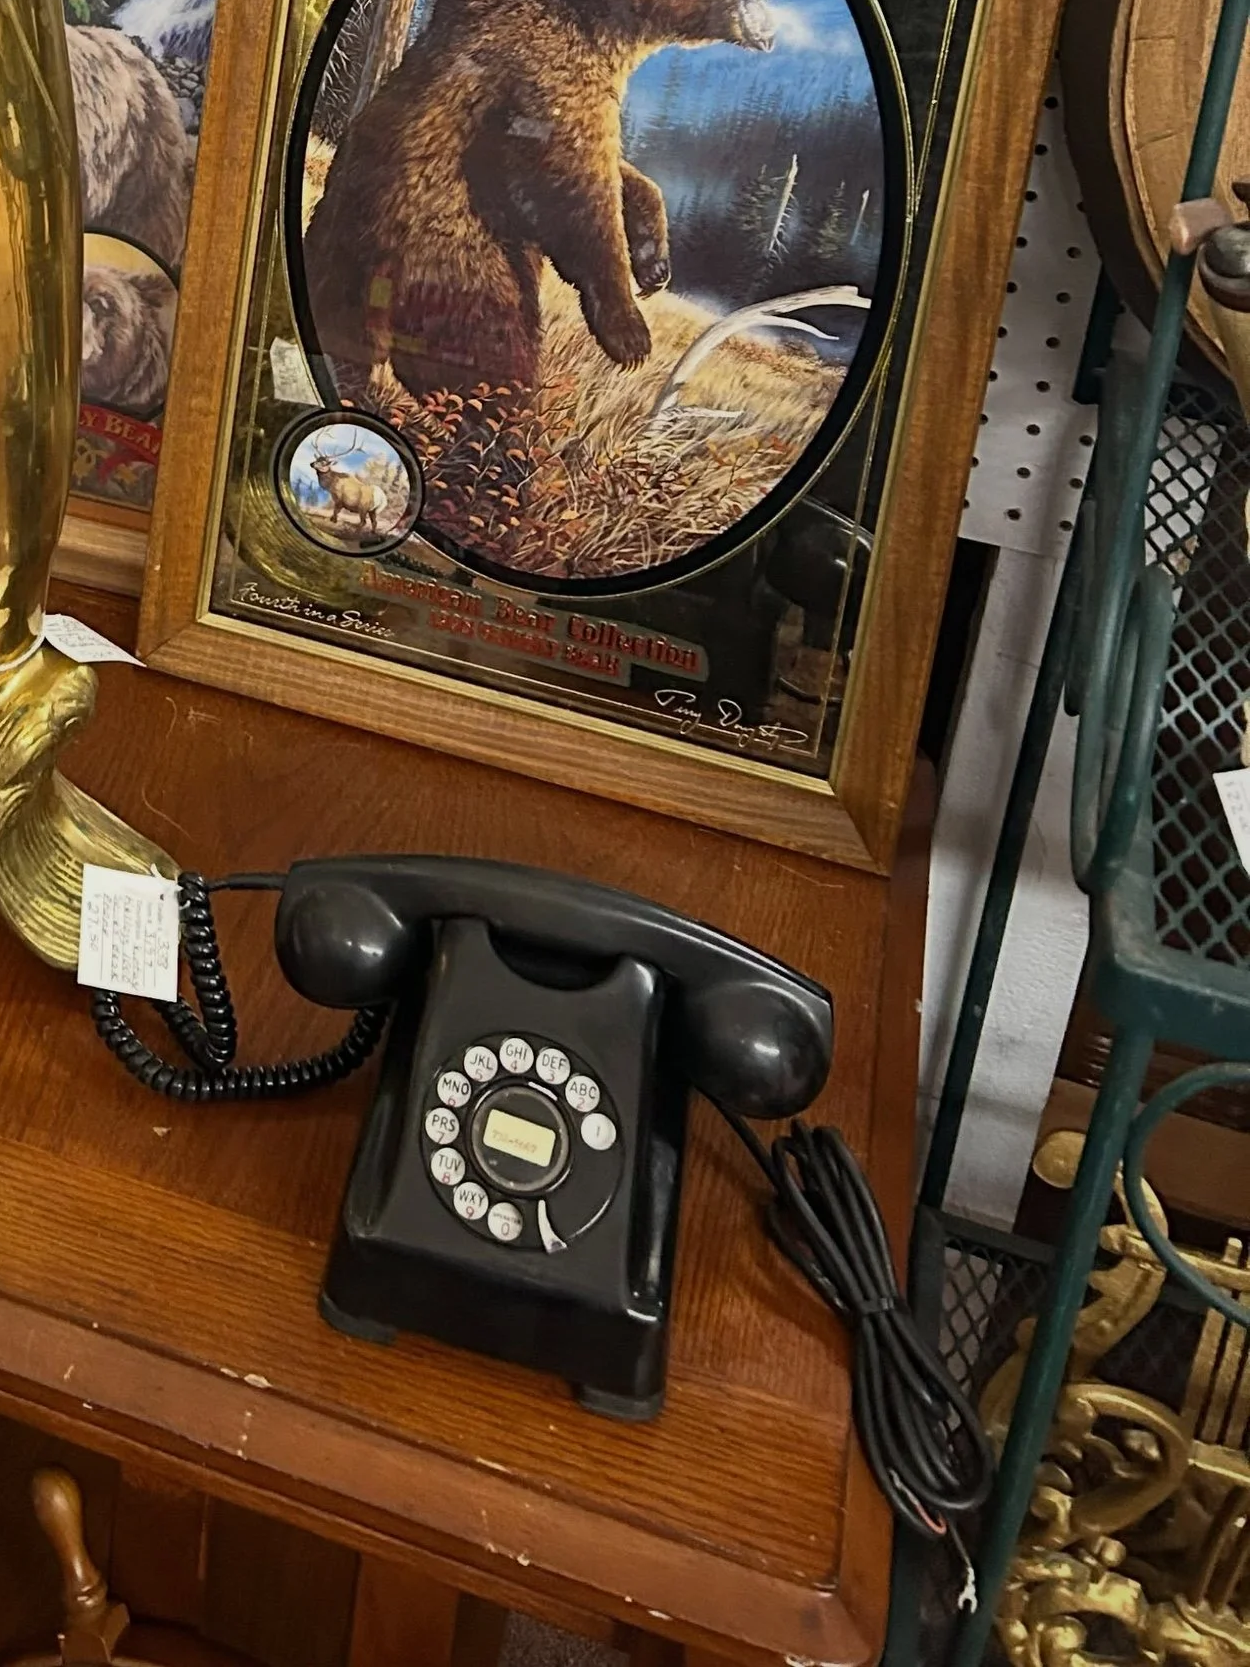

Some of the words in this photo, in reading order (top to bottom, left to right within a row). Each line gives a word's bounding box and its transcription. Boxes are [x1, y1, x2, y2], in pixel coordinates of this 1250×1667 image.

[360, 560, 482, 617] American
[495, 595, 557, 633] Bear
[568, 613, 699, 673] Collection
[469, 1052, 494, 1070] JKL
[505, 1043, 529, 1062] GHI
[510, 1059, 518, 1071] 4
[541, 1053, 567, 1071] DEF
[474, 1068, 483, 1081] 5
[548, 1070, 556, 1082] 3
[442, 1078, 470, 1095] MNO
[569, 1081, 597, 1100] ABC
[576, 1098, 586, 1110] 2
[431, 1114, 456, 1132] PRS
[437, 1130, 445, 1145] 7
[437, 1154, 462, 1171] TUV
[441, 1172, 450, 1184] 8
[458, 1189, 485, 1207] WXY
[465, 1205, 475, 1220] 9
